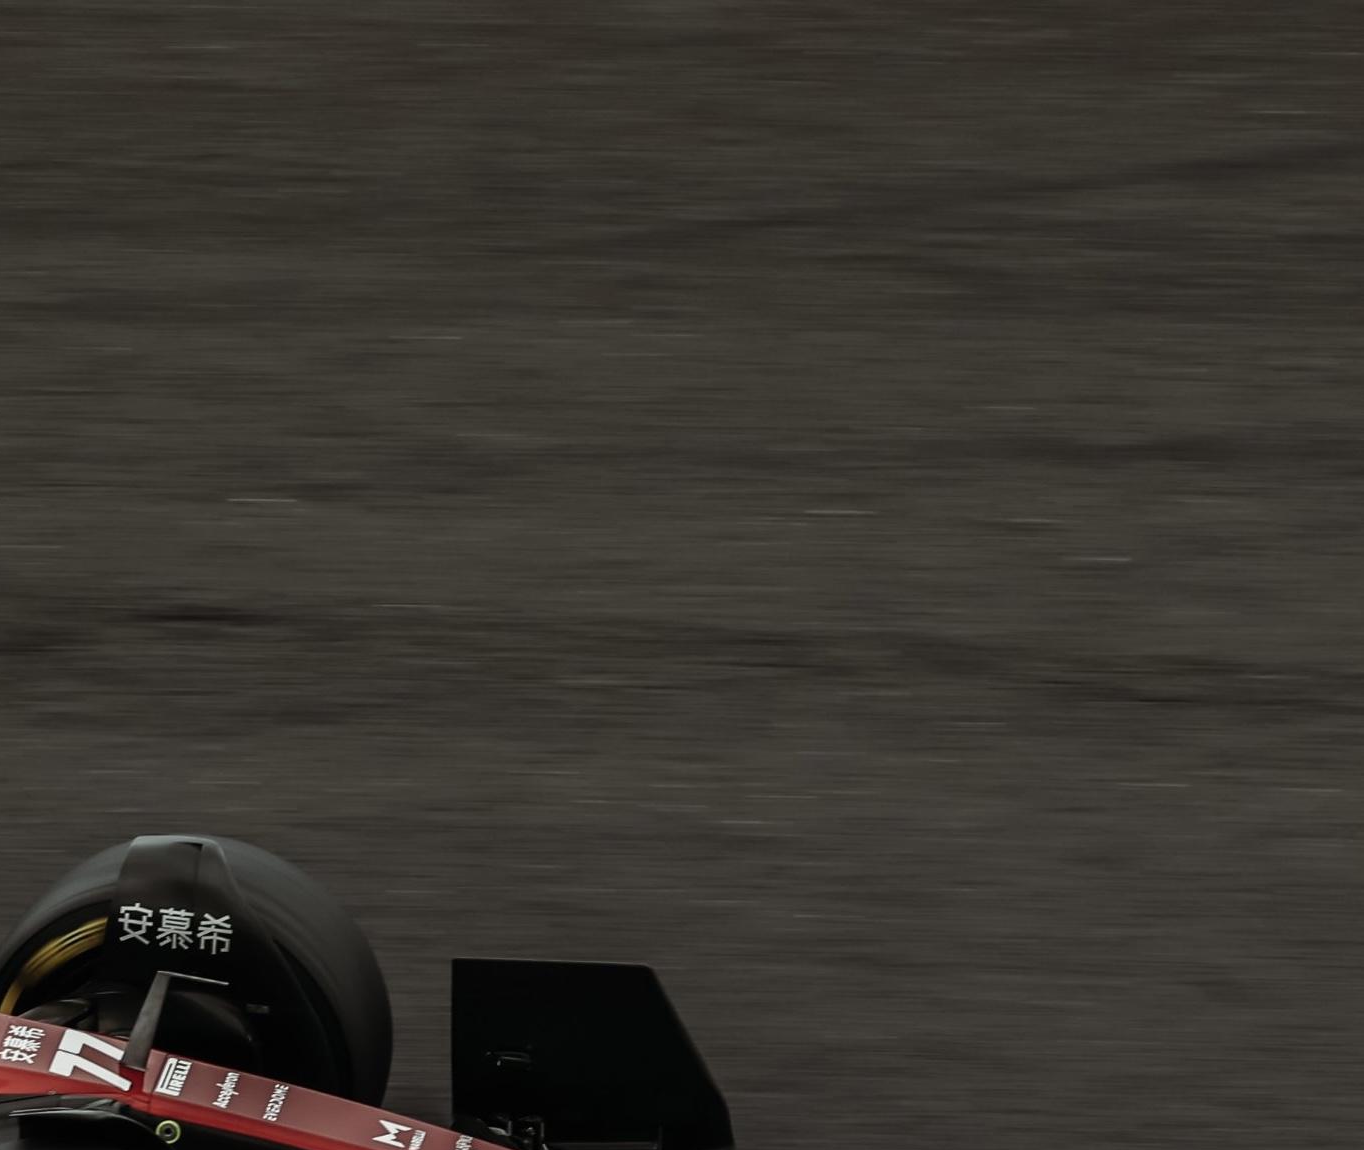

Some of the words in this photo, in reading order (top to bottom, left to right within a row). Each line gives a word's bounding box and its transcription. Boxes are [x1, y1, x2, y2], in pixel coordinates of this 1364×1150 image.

[118, 903, 233, 954] 安慕希
[49, 1028, 132, 1091] 77
[155, 1058, 193, 1097] PIRELLI
